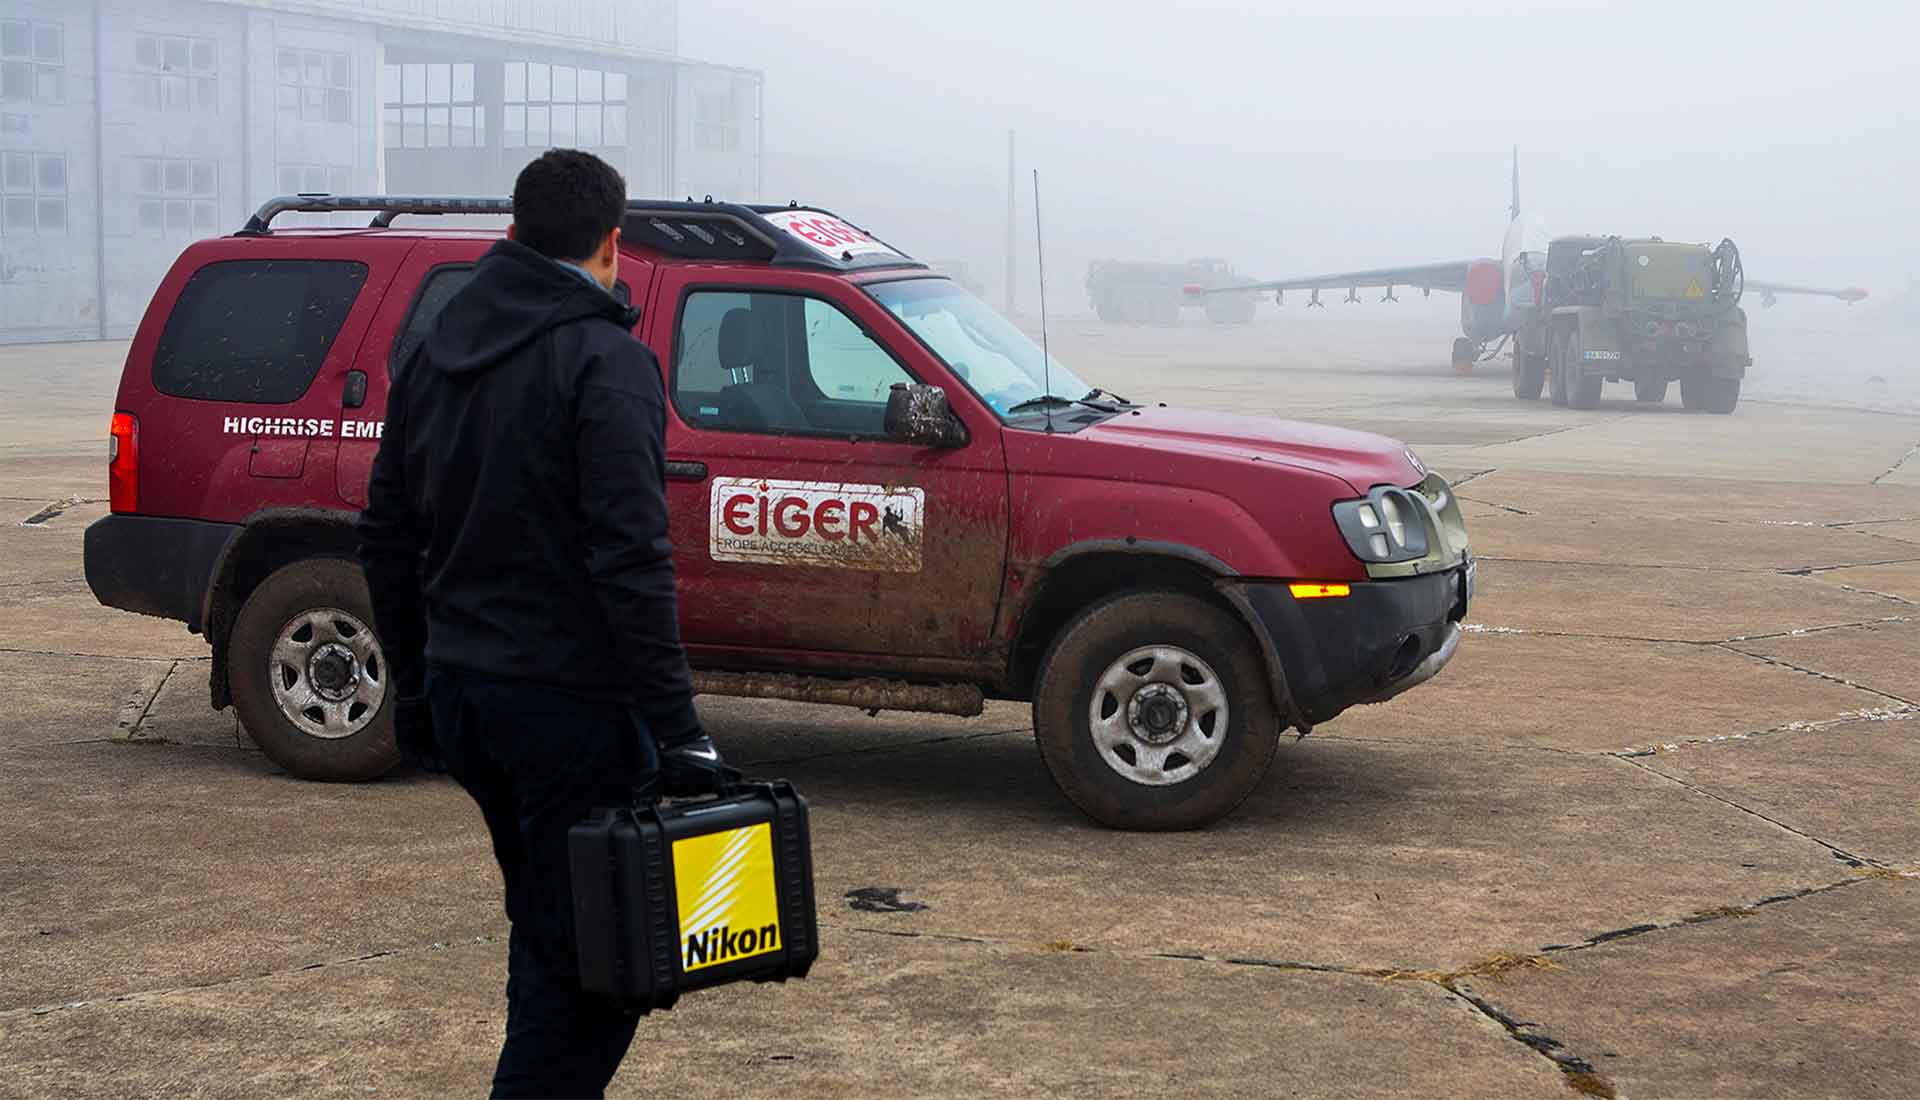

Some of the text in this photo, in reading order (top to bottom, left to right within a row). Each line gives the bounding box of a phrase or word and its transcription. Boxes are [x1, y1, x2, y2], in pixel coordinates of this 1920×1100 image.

[223, 416, 334, 436] HIGHRISE
[723, 484, 881, 543] EIGER
[724, 538, 757, 551] ROPE
[761, 541, 810, 555] ACCESS
[687, 923, 777, 968] Nikon
